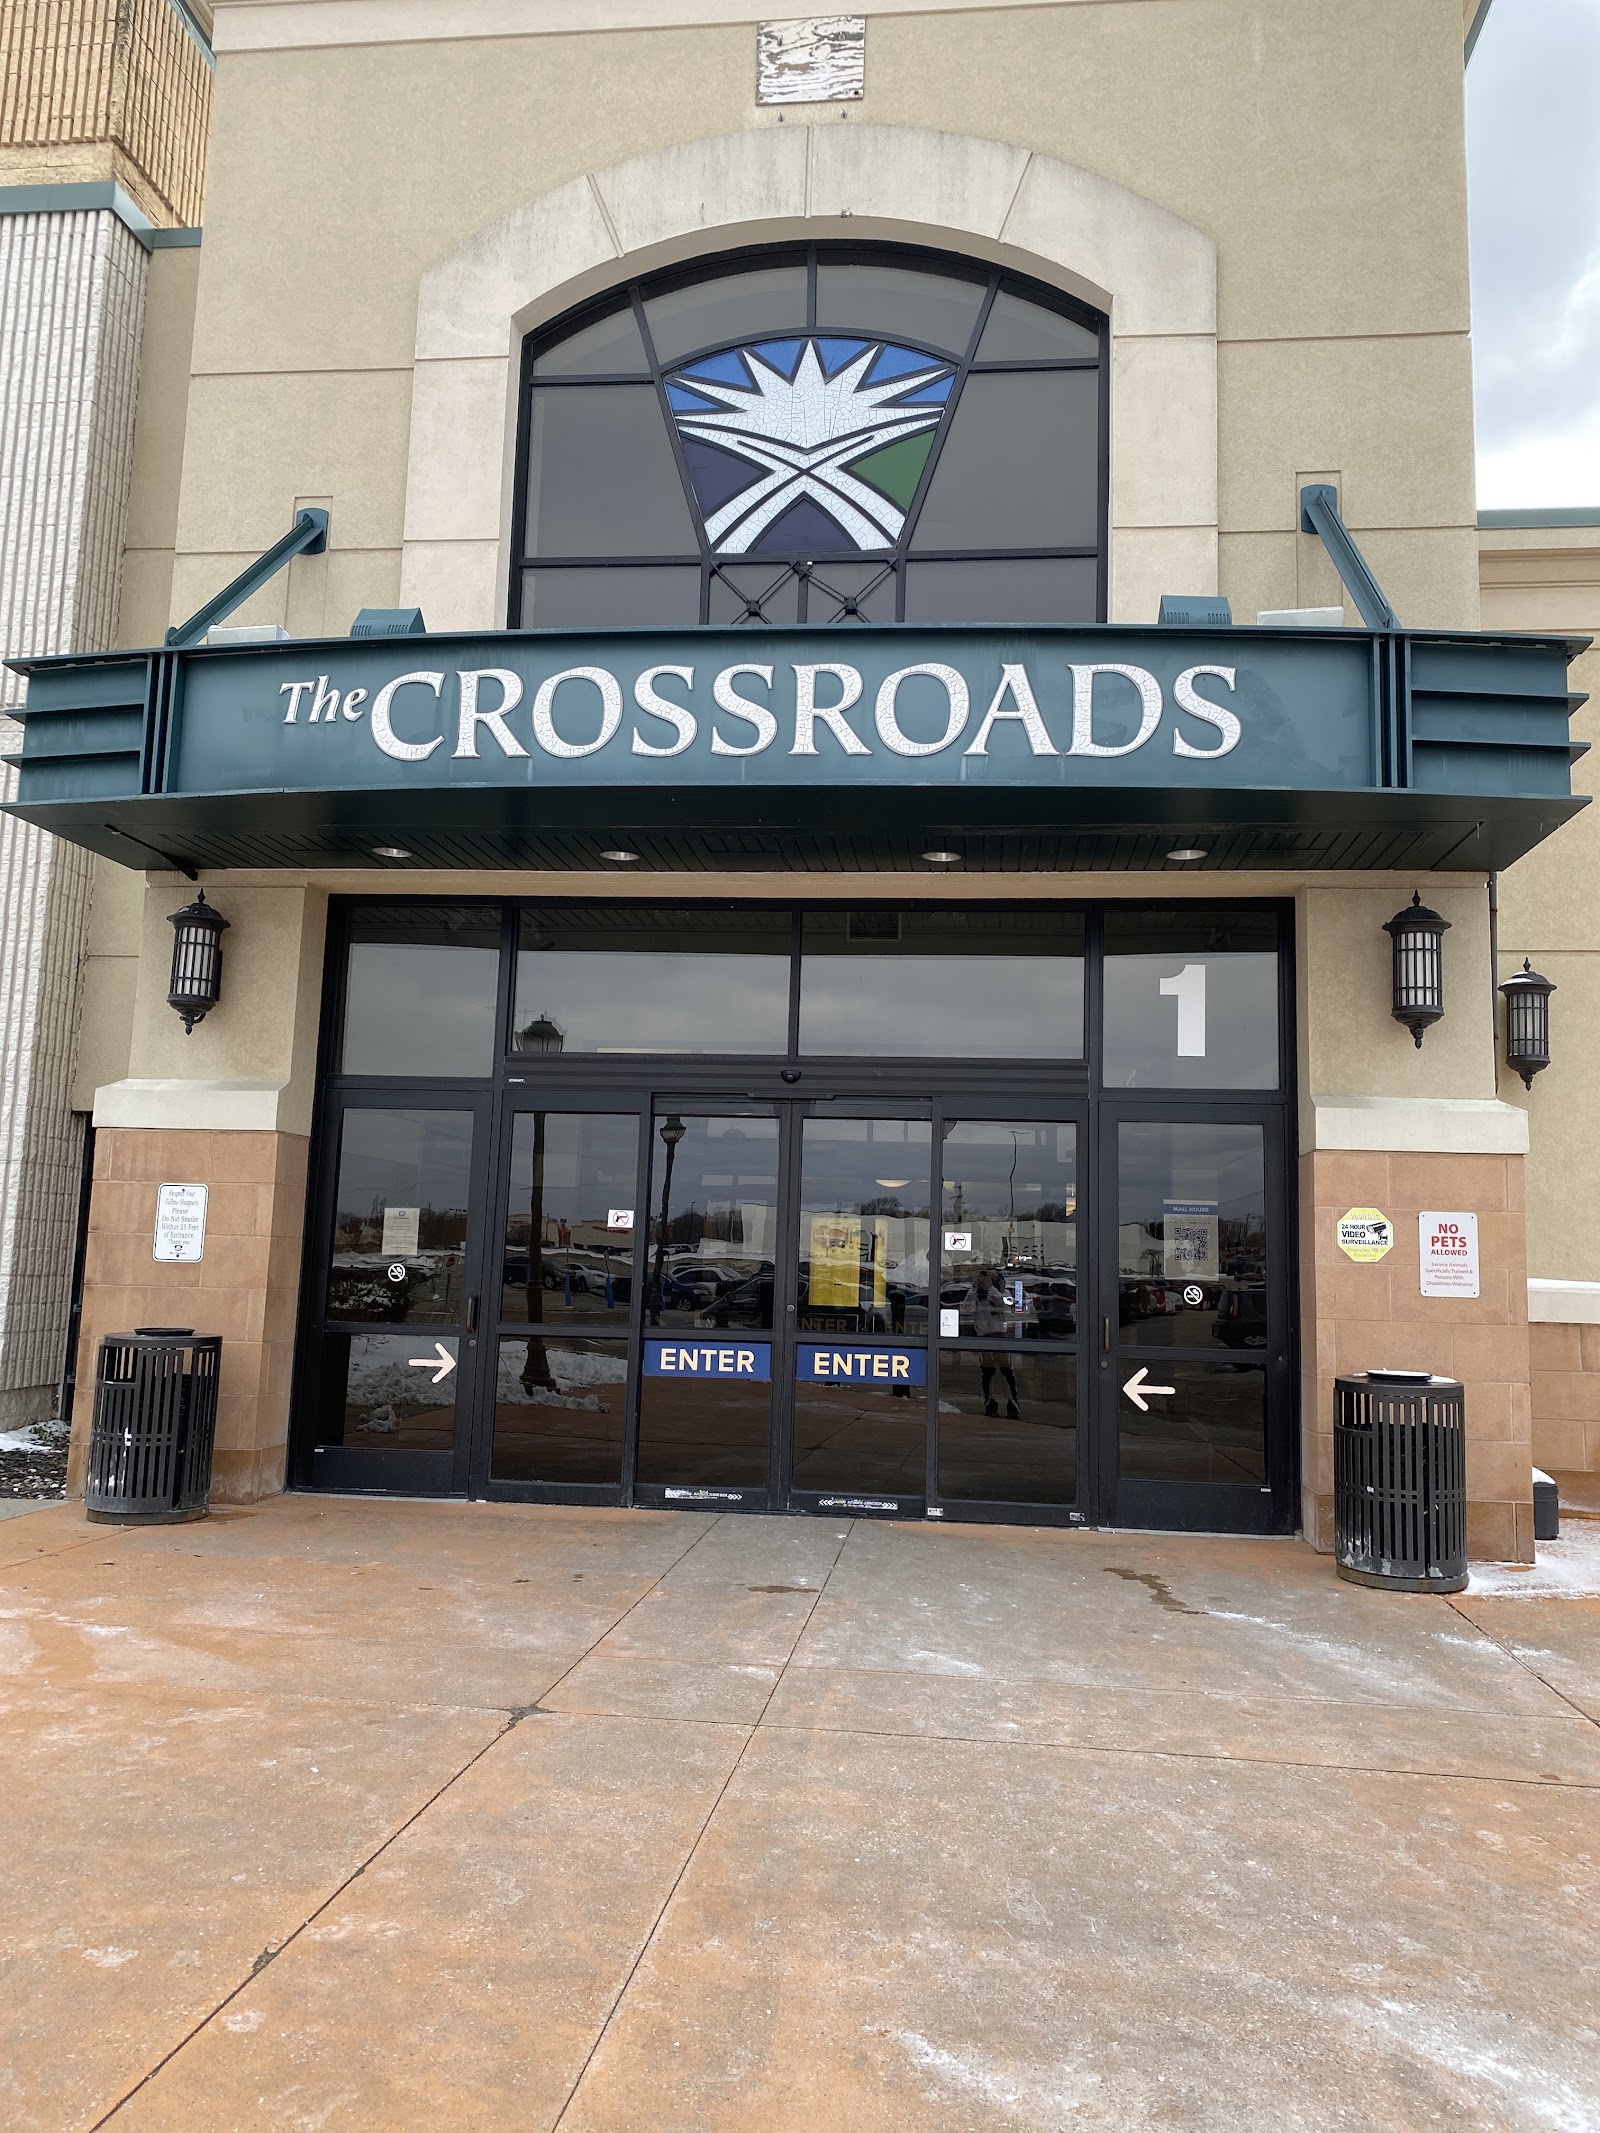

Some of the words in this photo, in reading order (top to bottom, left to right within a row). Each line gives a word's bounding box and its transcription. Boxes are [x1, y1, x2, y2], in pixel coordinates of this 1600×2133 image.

[279, 674, 369, 724] The
[371, 663, 1242, 761] CROSSROADS
[1160, 965, 1205, 1056] 1
[1341, 1230, 1366, 1238] VIDEO
[1438, 1223, 1459, 1234] NO
[1431, 1236, 1467, 1248] PETS
[660, 1348, 755, 1373] ENTER
[814, 1352, 910, 1378] ENTER
